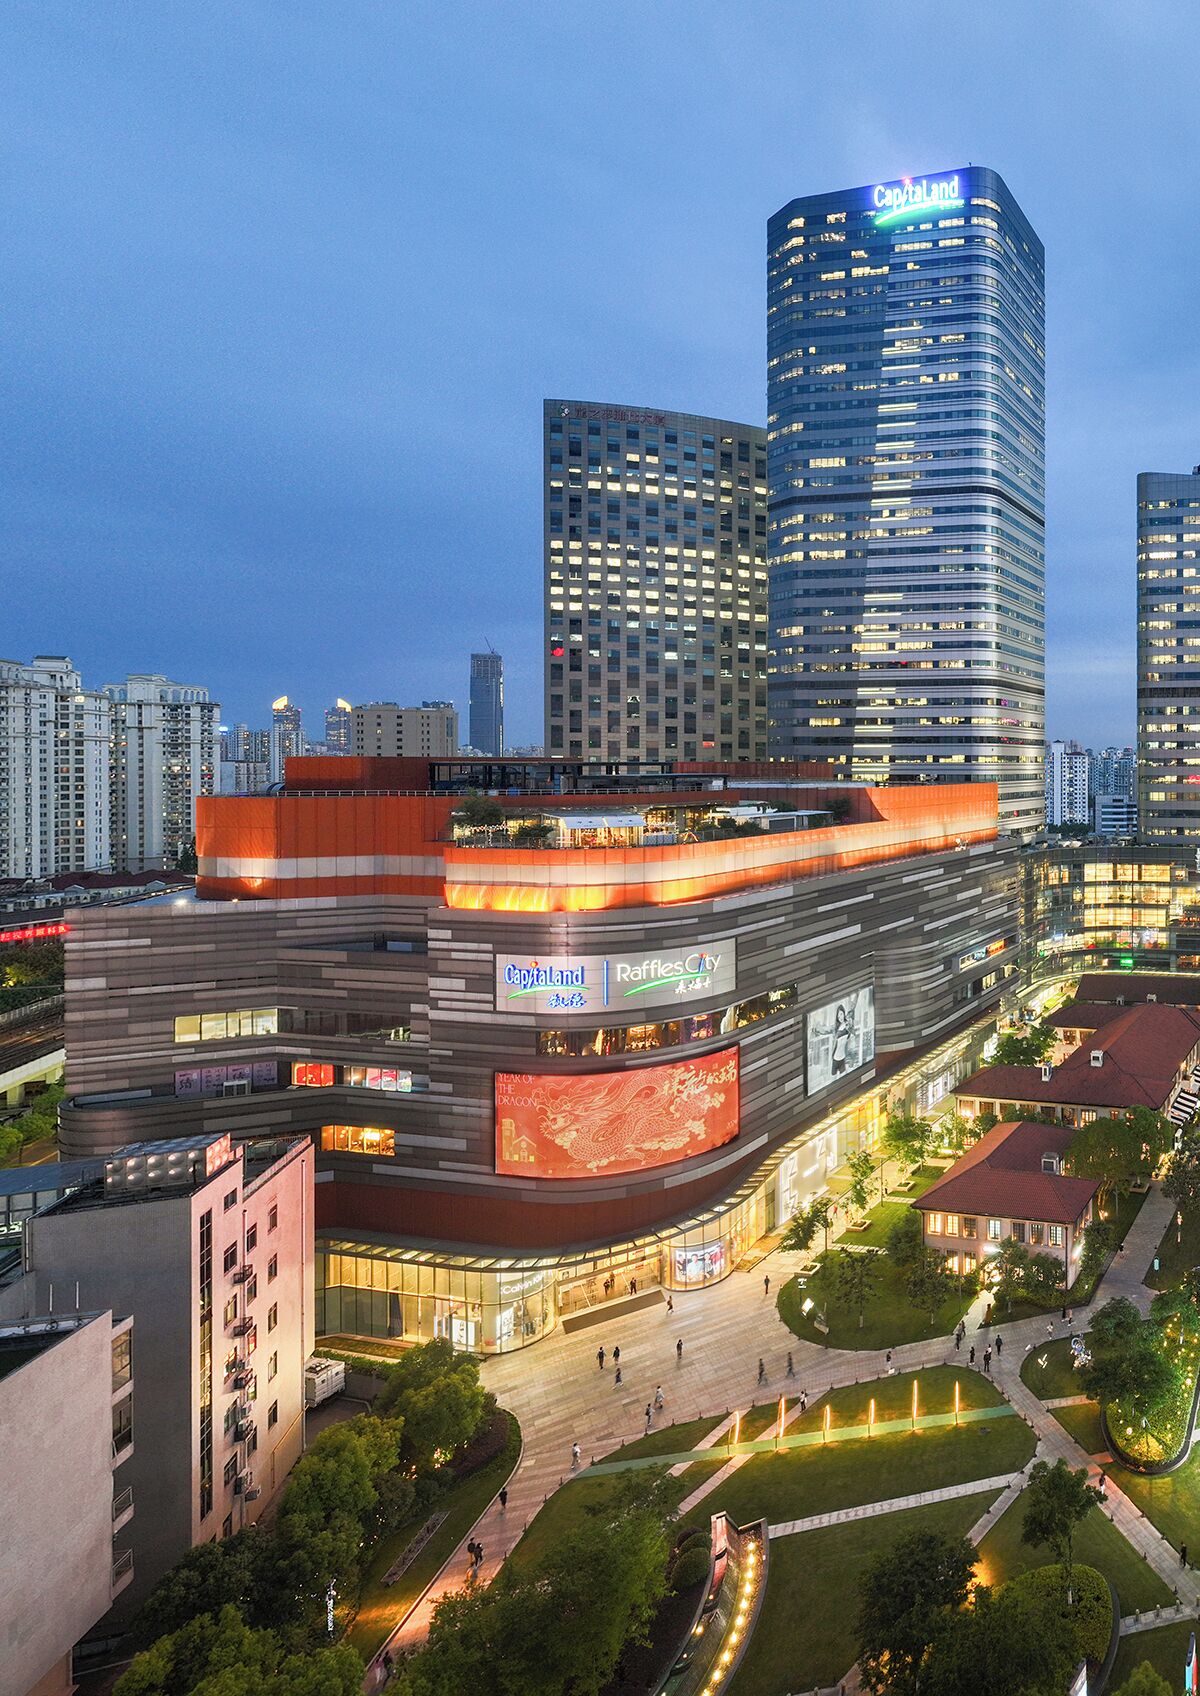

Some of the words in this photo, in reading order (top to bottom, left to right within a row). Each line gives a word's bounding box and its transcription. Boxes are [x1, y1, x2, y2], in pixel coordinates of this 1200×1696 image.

[873, 175, 959, 212] CapitaLand
[504, 961, 585, 990] CapitaLand
[616, 959, 684, 982] Raffles
[684, 953, 721, 974] City
[499, 1073, 521, 1083] YEAR
[523, 1074, 535, 1084] OF
[499, 1083, 516, 1094] THE
[498, 1095, 537, 1107] DRAGON
